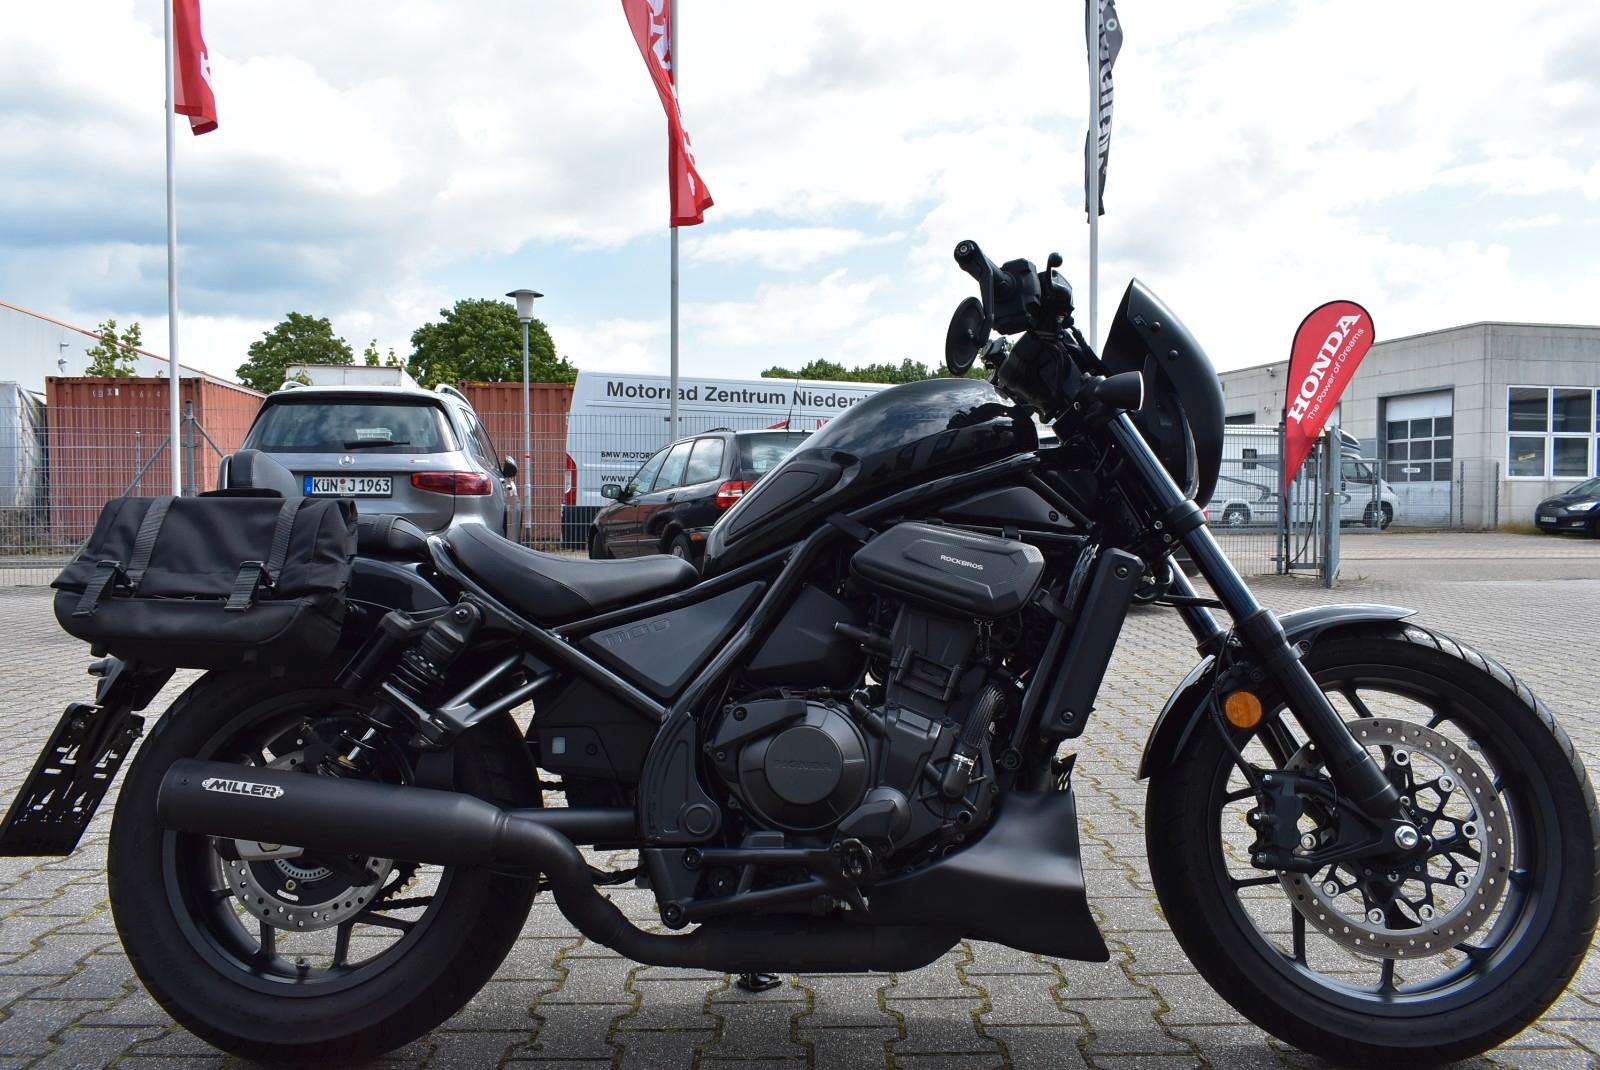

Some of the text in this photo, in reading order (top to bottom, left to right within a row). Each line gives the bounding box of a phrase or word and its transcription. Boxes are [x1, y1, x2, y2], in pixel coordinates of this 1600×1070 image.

[1287, 314, 1361, 424] HONDA
[1307, 328, 1364, 420] The Power of Dreams
[704, 386, 785, 405] Zentrum
[601, 451, 620, 459] BMW
[313, 479, 390, 492] KÜN J 1963
[940, 554, 984, 570] ROCKBROS
[208, 779, 277, 798] MILLER
